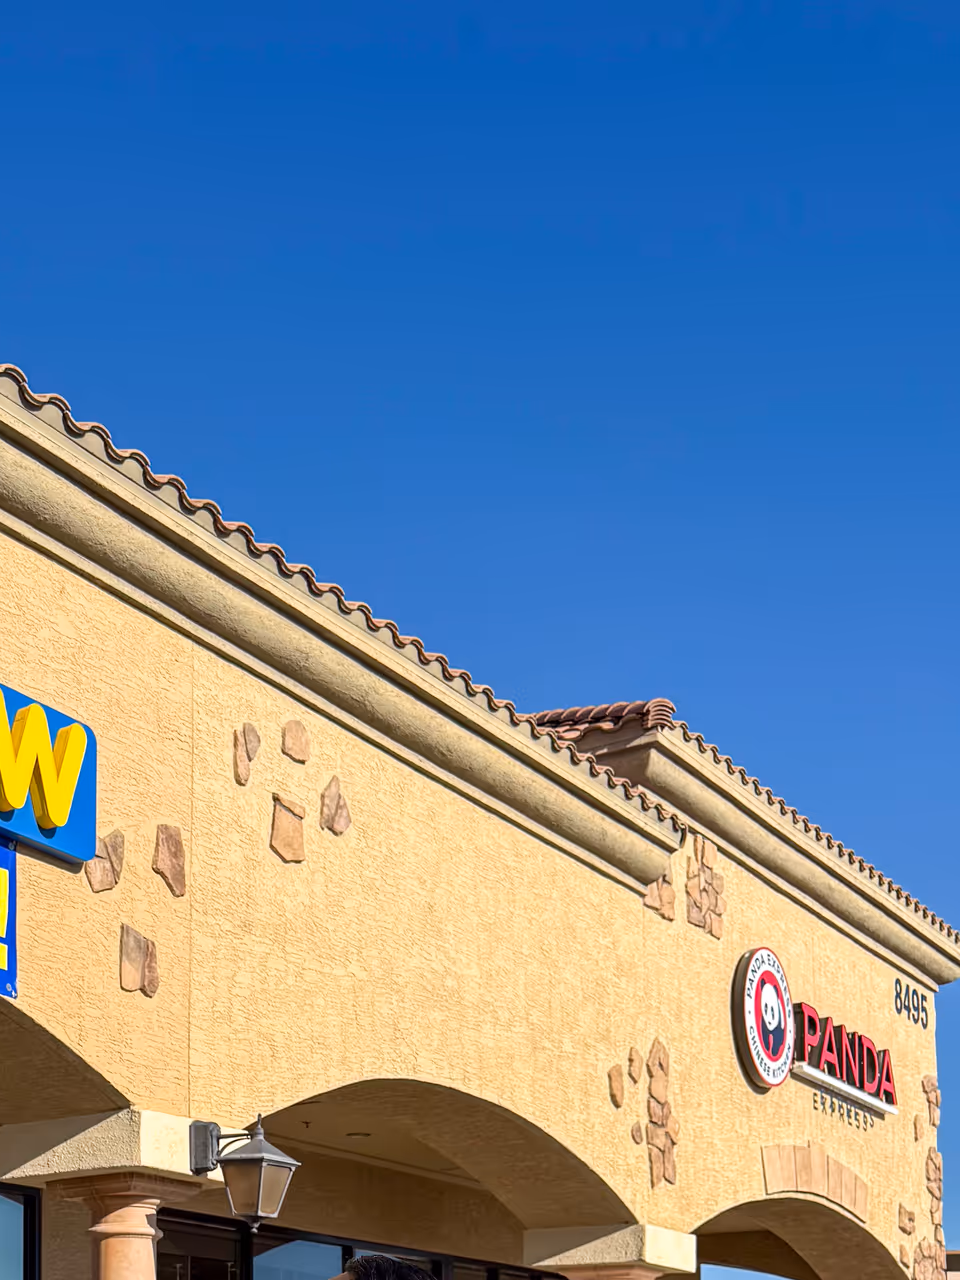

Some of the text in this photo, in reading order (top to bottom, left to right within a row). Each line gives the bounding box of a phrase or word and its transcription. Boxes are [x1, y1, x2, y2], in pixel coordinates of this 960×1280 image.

[747, 953, 766, 999] PANDA
[894, 978, 929, 1030] 8495
[749, 1026, 771, 1077] CHINESE
[798, 1002, 898, 1106] PANDA
